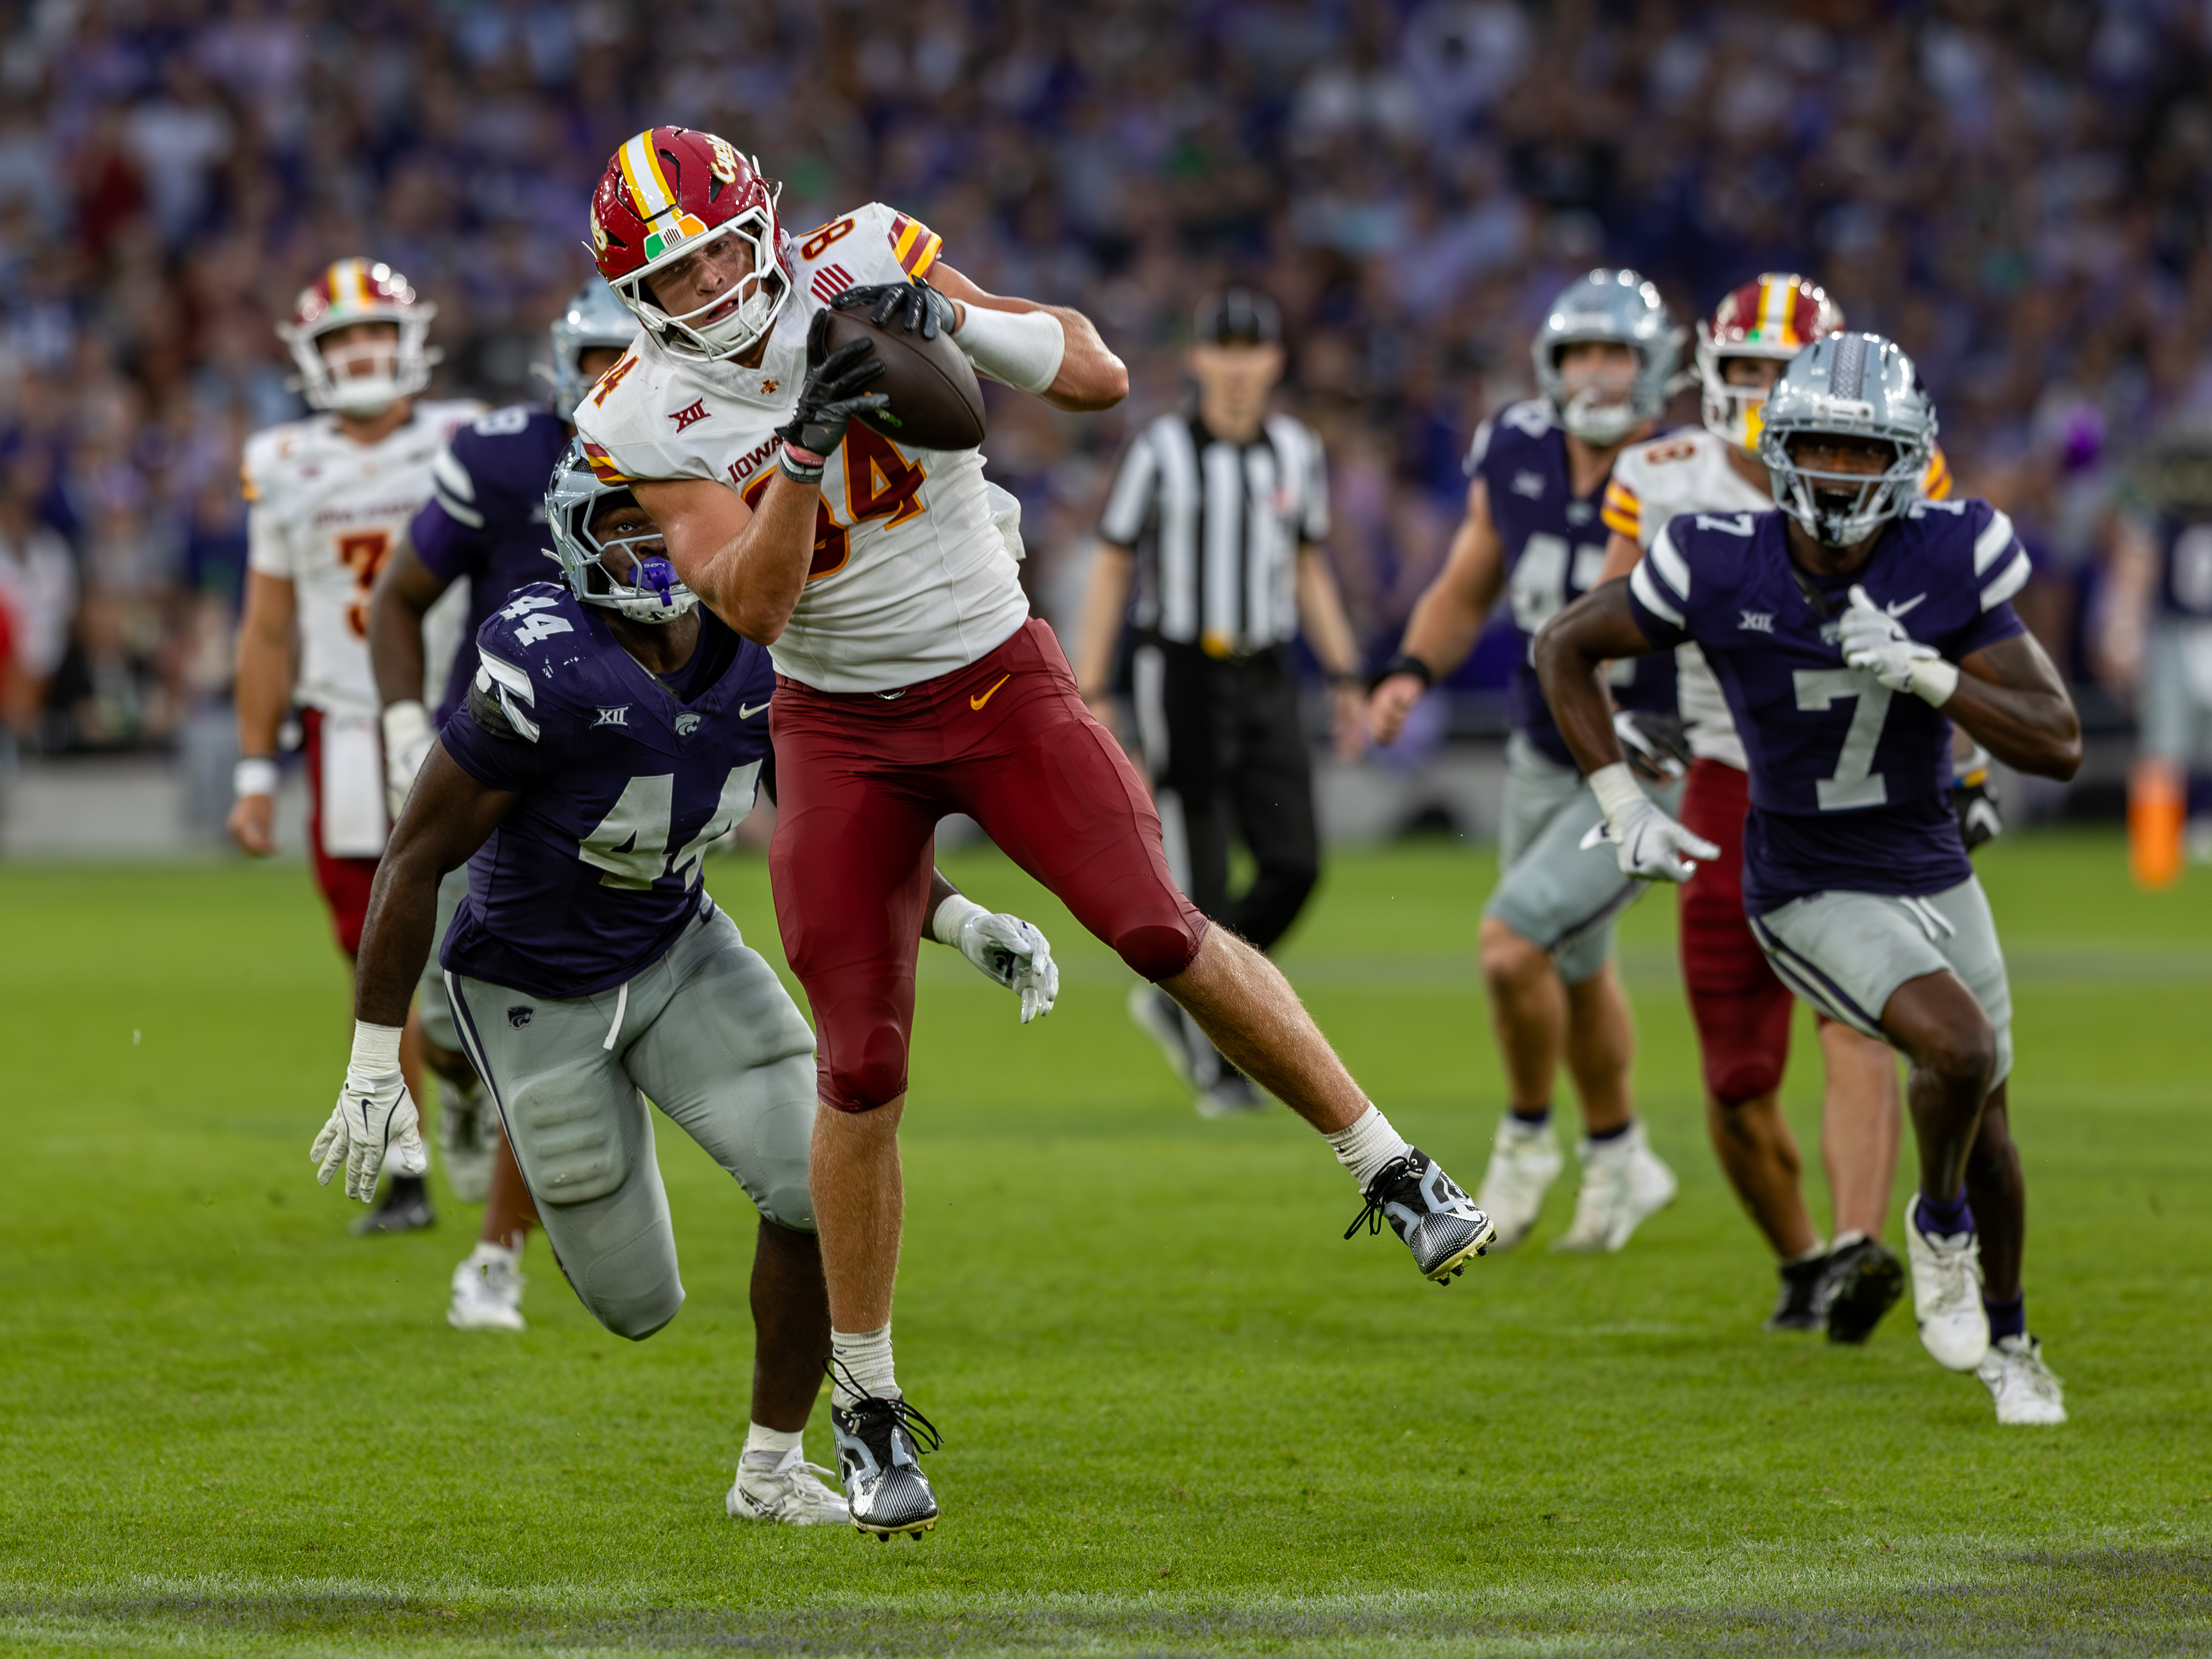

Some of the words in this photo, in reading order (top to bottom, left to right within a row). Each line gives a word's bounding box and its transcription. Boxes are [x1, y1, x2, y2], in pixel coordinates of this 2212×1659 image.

[797, 215, 856, 262] 8
[588, 344, 639, 409] 4
[667, 396, 712, 435] XII
[727, 435, 783, 484] IOWA
[1695, 511, 1756, 537] 7
[499, 595, 574, 647] 44
[1737, 609, 1774, 634] XII
[593, 706, 629, 727] XII
[1792, 666, 1895, 811] 7
[578, 758, 763, 892] 44
